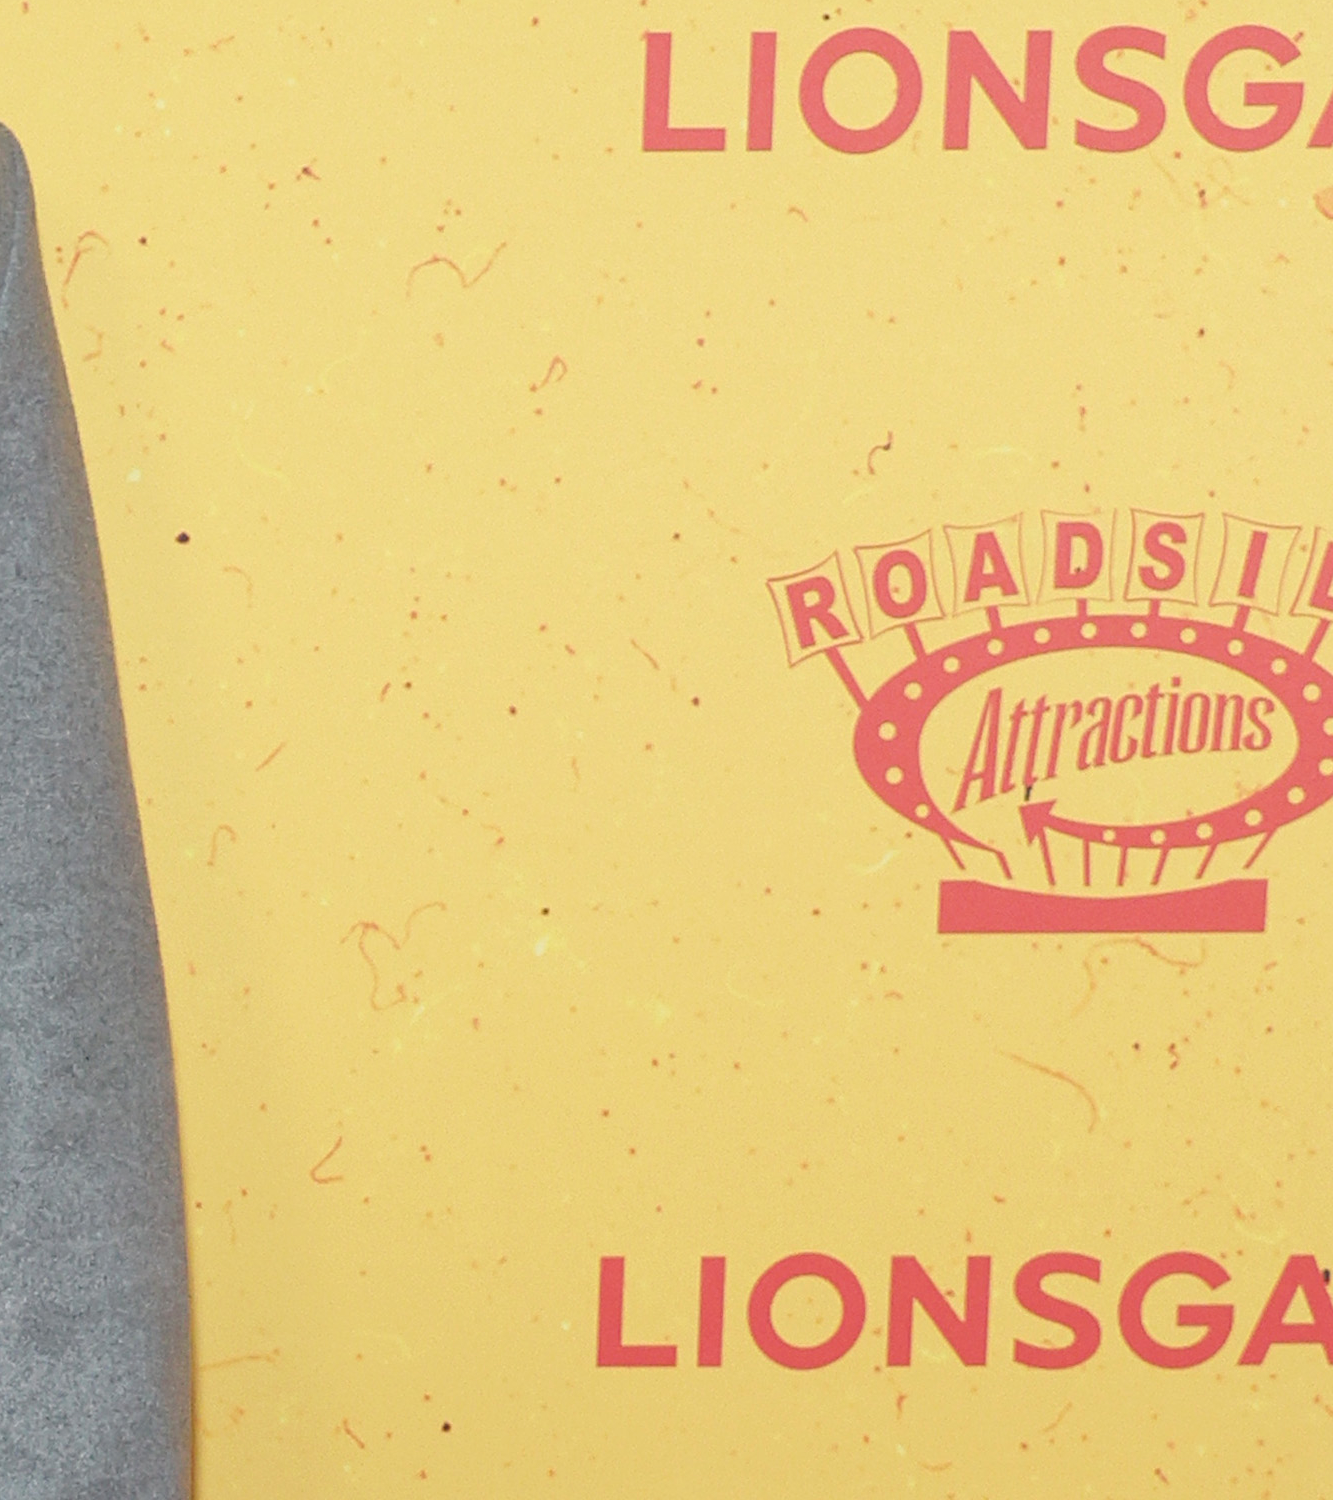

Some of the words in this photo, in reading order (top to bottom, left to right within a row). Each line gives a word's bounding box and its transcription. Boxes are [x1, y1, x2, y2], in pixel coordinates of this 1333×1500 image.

[641, 25, 1333, 155] LIONSG
[950, 672, 1275, 812] Attractions
[596, 1252, 1333, 1371] LIONSGA
